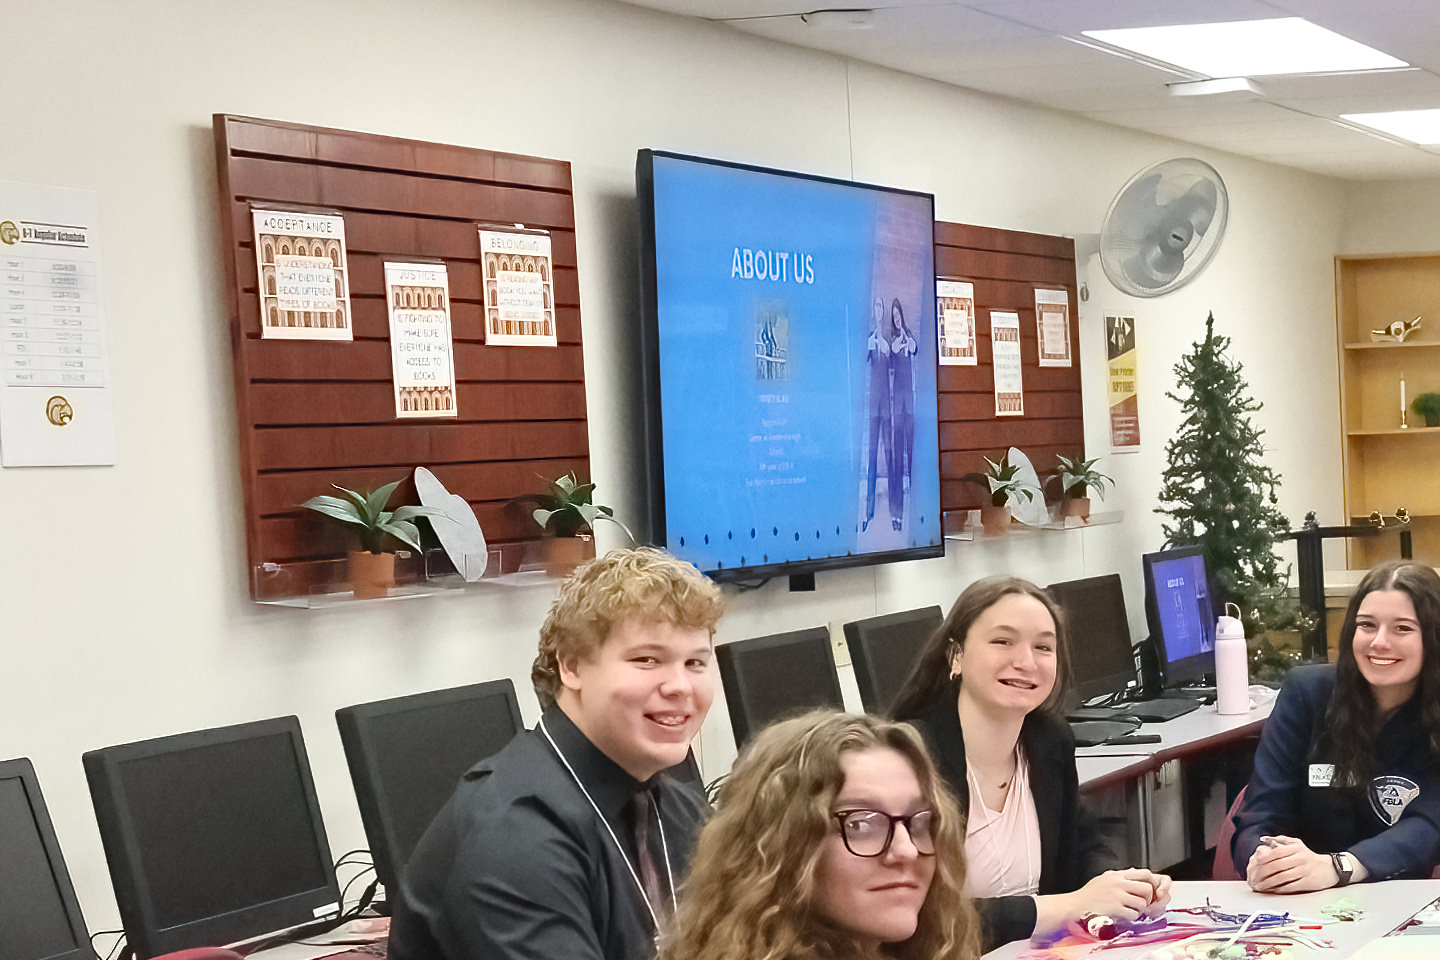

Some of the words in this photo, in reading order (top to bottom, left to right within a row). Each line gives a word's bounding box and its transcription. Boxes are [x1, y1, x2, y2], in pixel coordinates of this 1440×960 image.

[264, 217, 333, 233] ACCEPTANCE
[491, 238, 539, 251] BELONGING
[731, 247, 789, 282] ABOUT
[793, 252, 815, 285] US
[399, 272, 437, 281] JUSTICE
